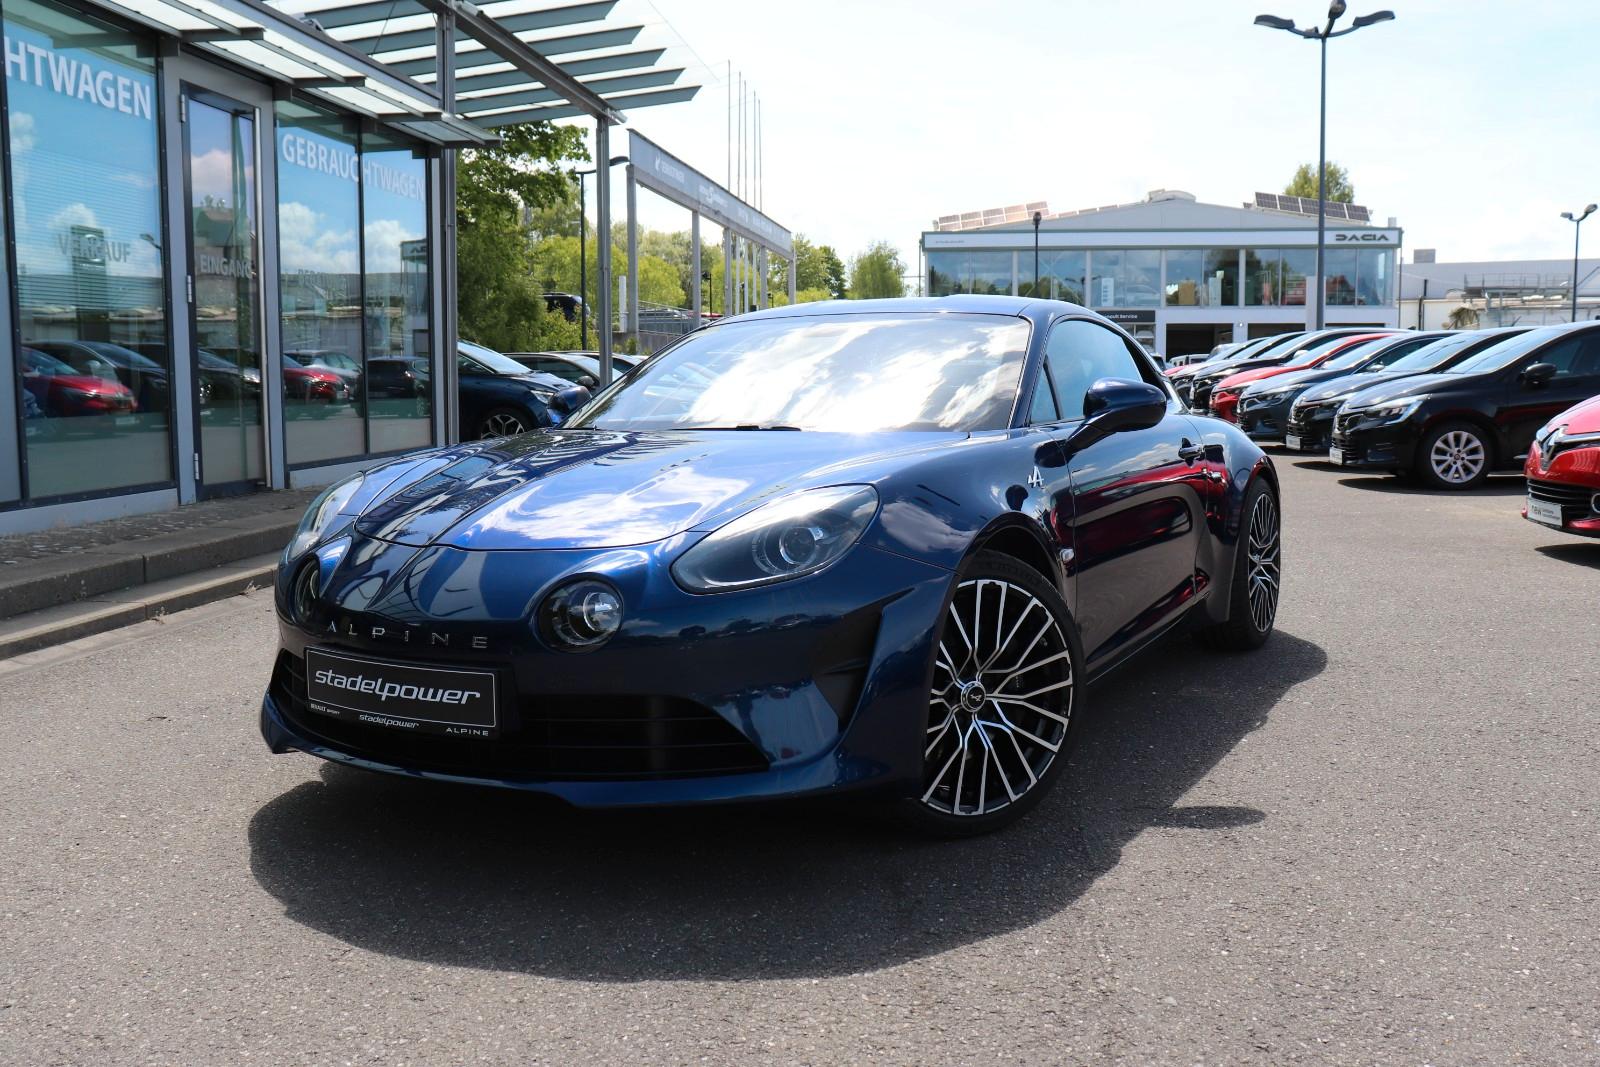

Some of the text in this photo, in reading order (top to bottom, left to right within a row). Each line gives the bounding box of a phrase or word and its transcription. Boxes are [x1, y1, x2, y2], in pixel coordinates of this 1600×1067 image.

[4, 36, 151, 120] HTWAGEN
[282, 133, 424, 200] GEBRAUCHTWAGEN
[1335, 233, 1389, 241] DACIA
[327, 621, 488, 649] ALPINE
[315, 669, 481, 705] stadelpower
[359, 713, 419, 729] stadelpower
[446, 727, 489, 736] ALPINE
